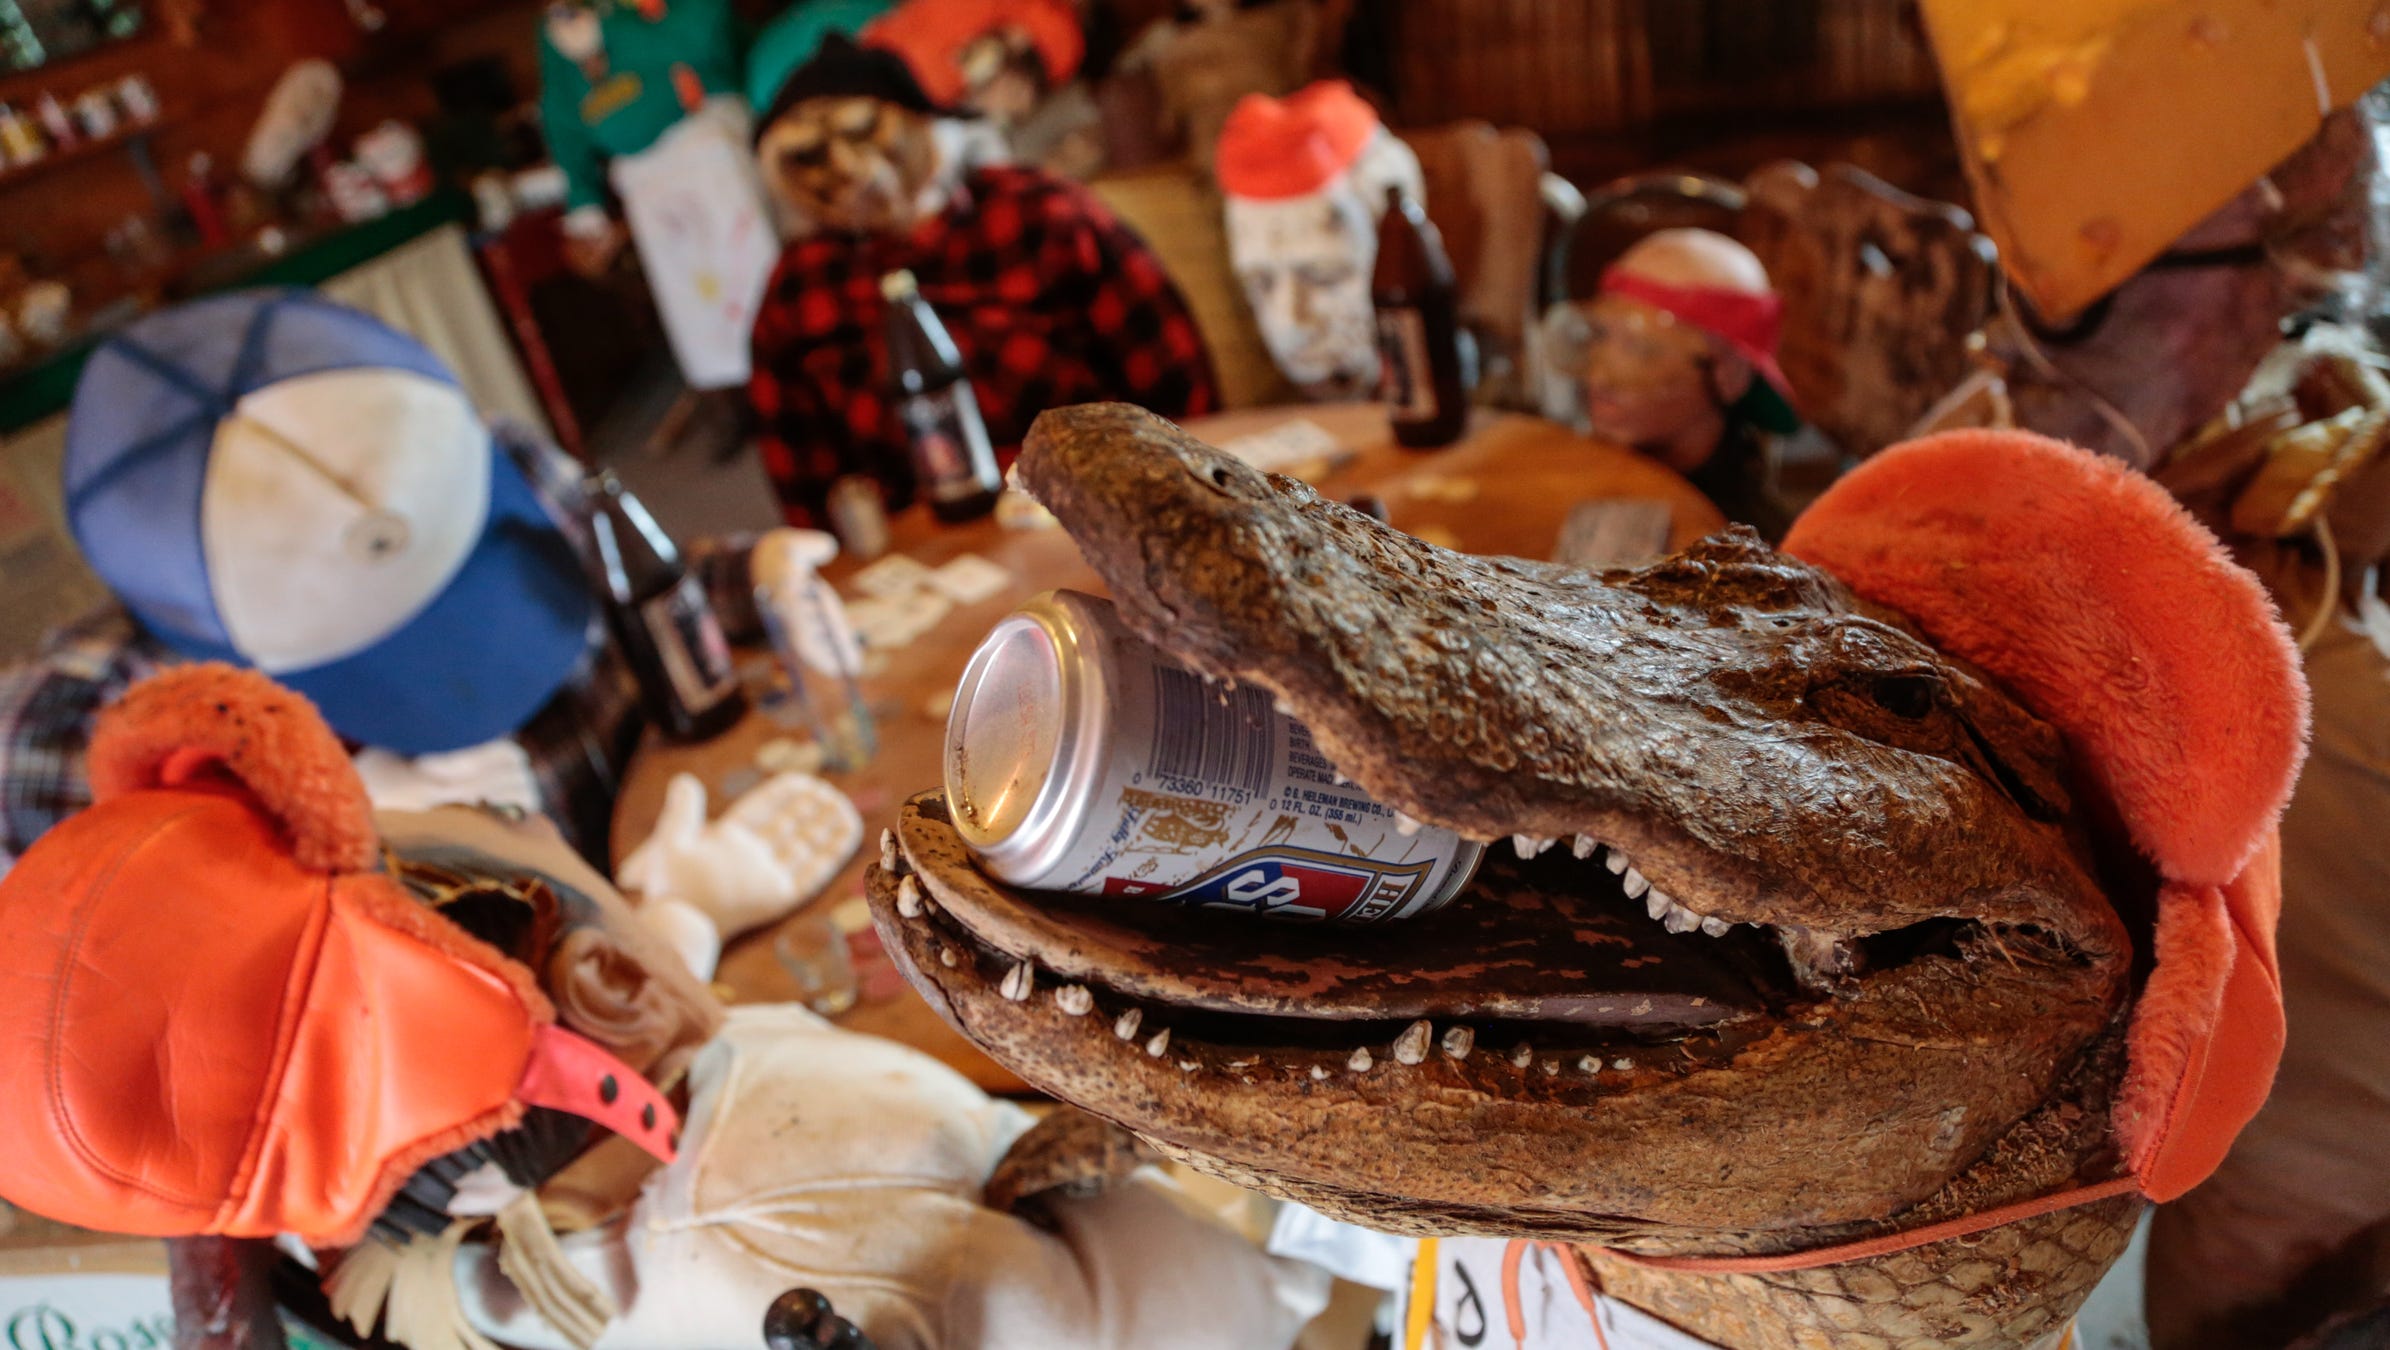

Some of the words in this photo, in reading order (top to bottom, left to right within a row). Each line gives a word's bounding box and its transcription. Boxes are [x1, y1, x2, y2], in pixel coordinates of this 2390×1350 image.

[1288, 766, 1317, 783] OPERATE
[1159, 774, 1203, 796] 73360
[1212, 785, 1252, 805] 11751
[1303, 789, 1338, 806] HEILEMAN
[1340, 797, 1371, 813] BREWING
[1282, 799, 1292, 811] 12
[1293, 801, 1306, 814] FL.
[1309, 804, 1322, 817] OZ.
[1325, 807, 1344, 821] (355
